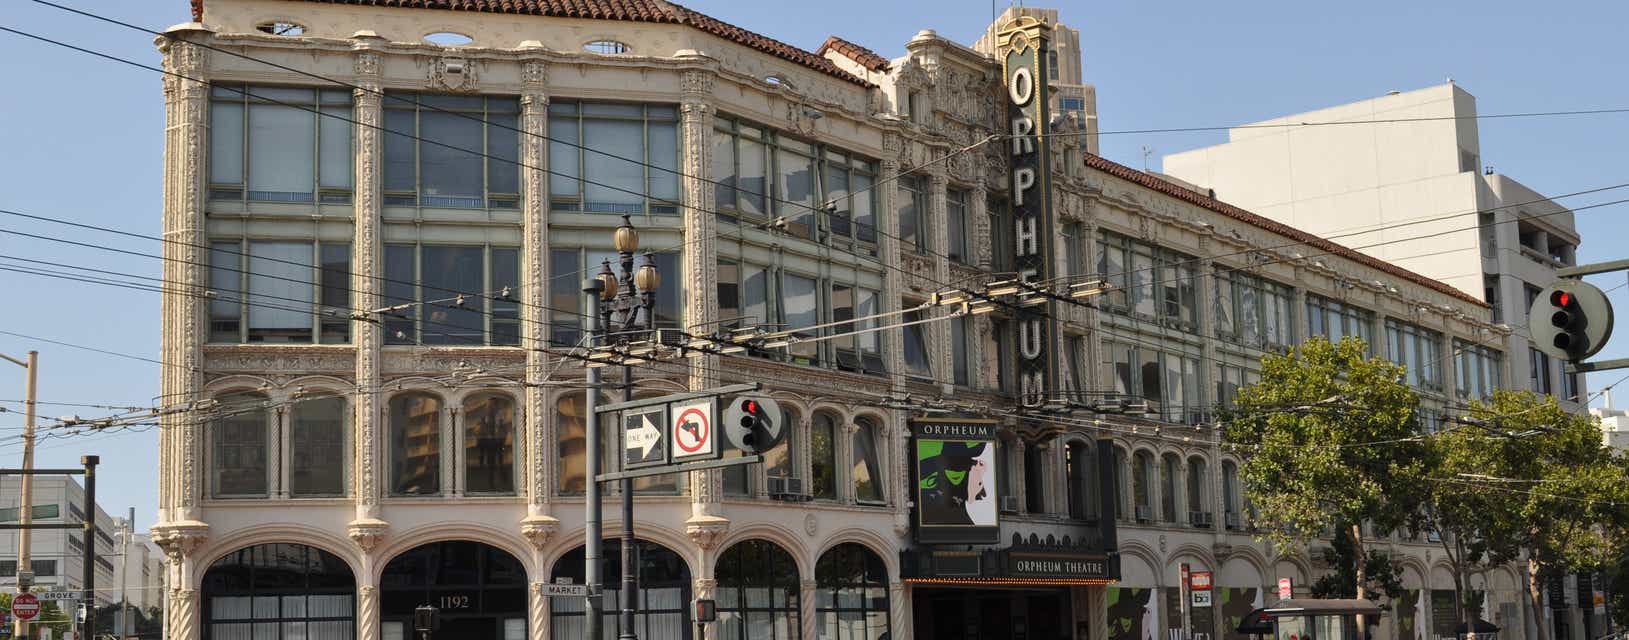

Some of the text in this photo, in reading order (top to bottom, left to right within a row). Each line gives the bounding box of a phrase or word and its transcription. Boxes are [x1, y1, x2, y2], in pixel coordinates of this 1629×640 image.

[924, 424, 988, 435] ORPHEUM
[627, 432, 641, 442] ONE
[1017, 560, 1102, 573] ORPHEUM THEATRE
[549, 586, 583, 595] MARKET
[441, 595, 469, 608] 1192
